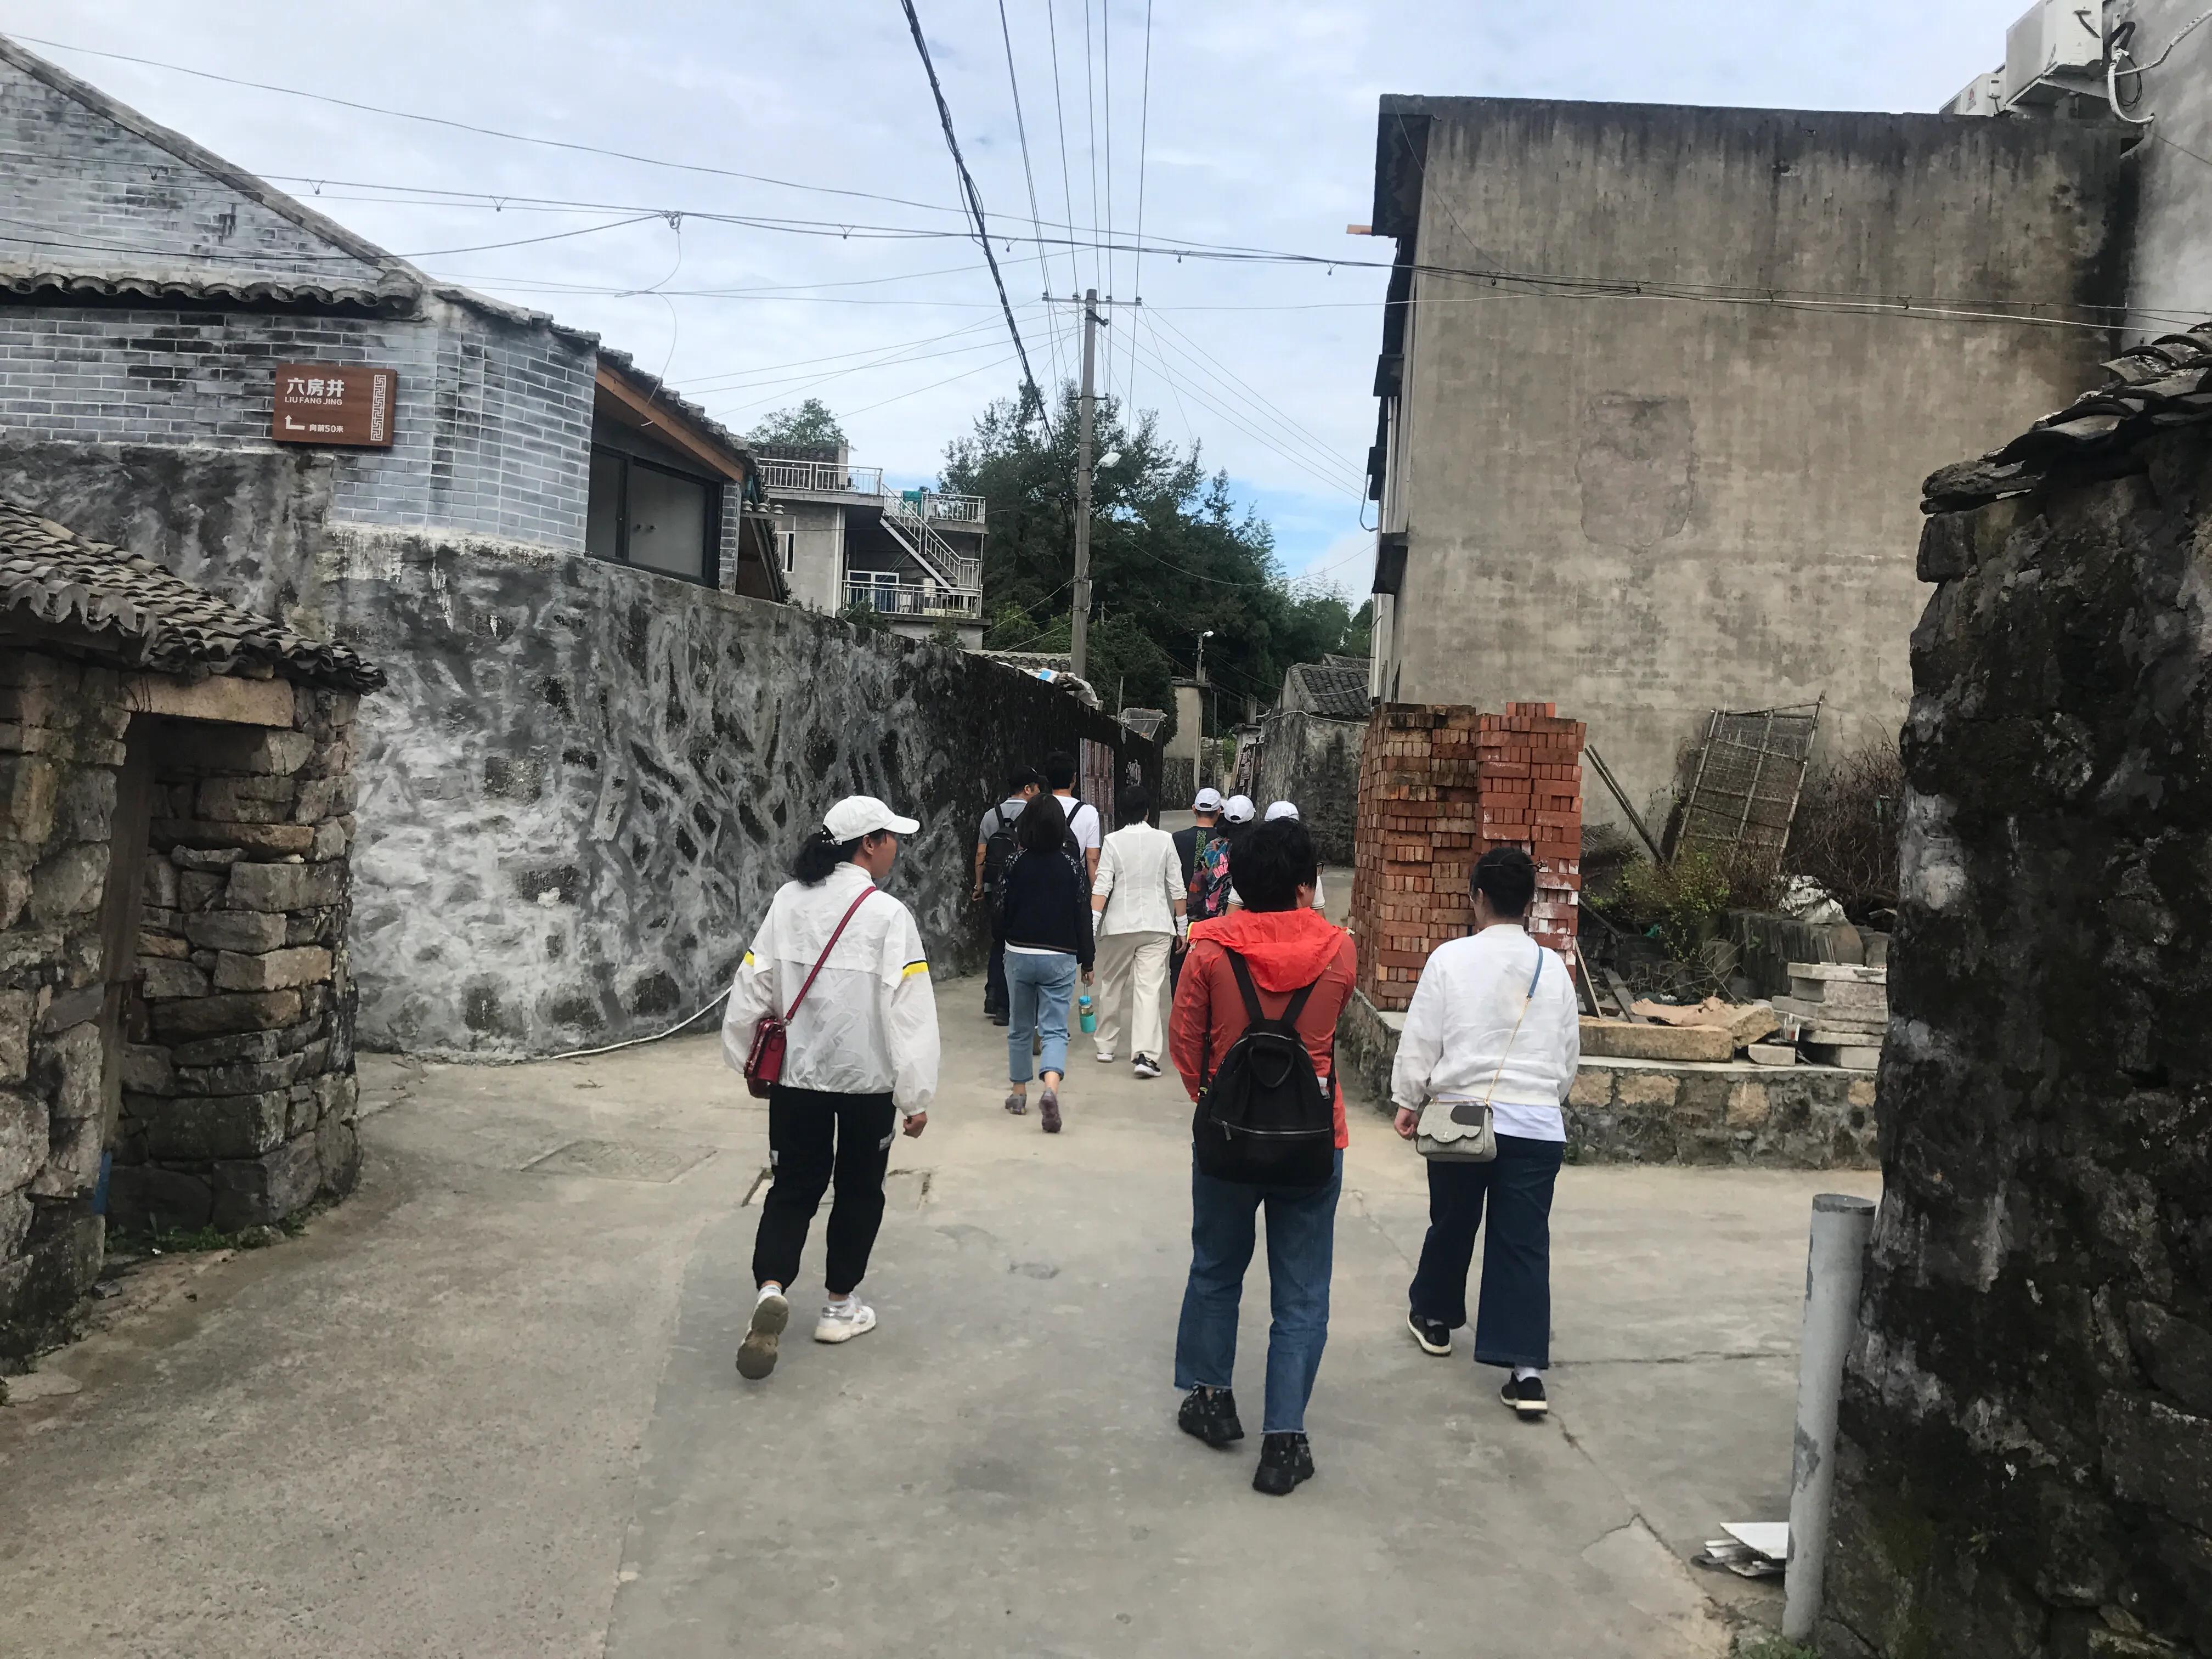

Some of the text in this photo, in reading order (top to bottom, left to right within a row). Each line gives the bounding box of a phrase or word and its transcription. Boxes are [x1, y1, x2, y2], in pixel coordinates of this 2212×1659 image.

[286, 377, 345, 397] 六房井
[309, 424, 344, 433] 向前50米
